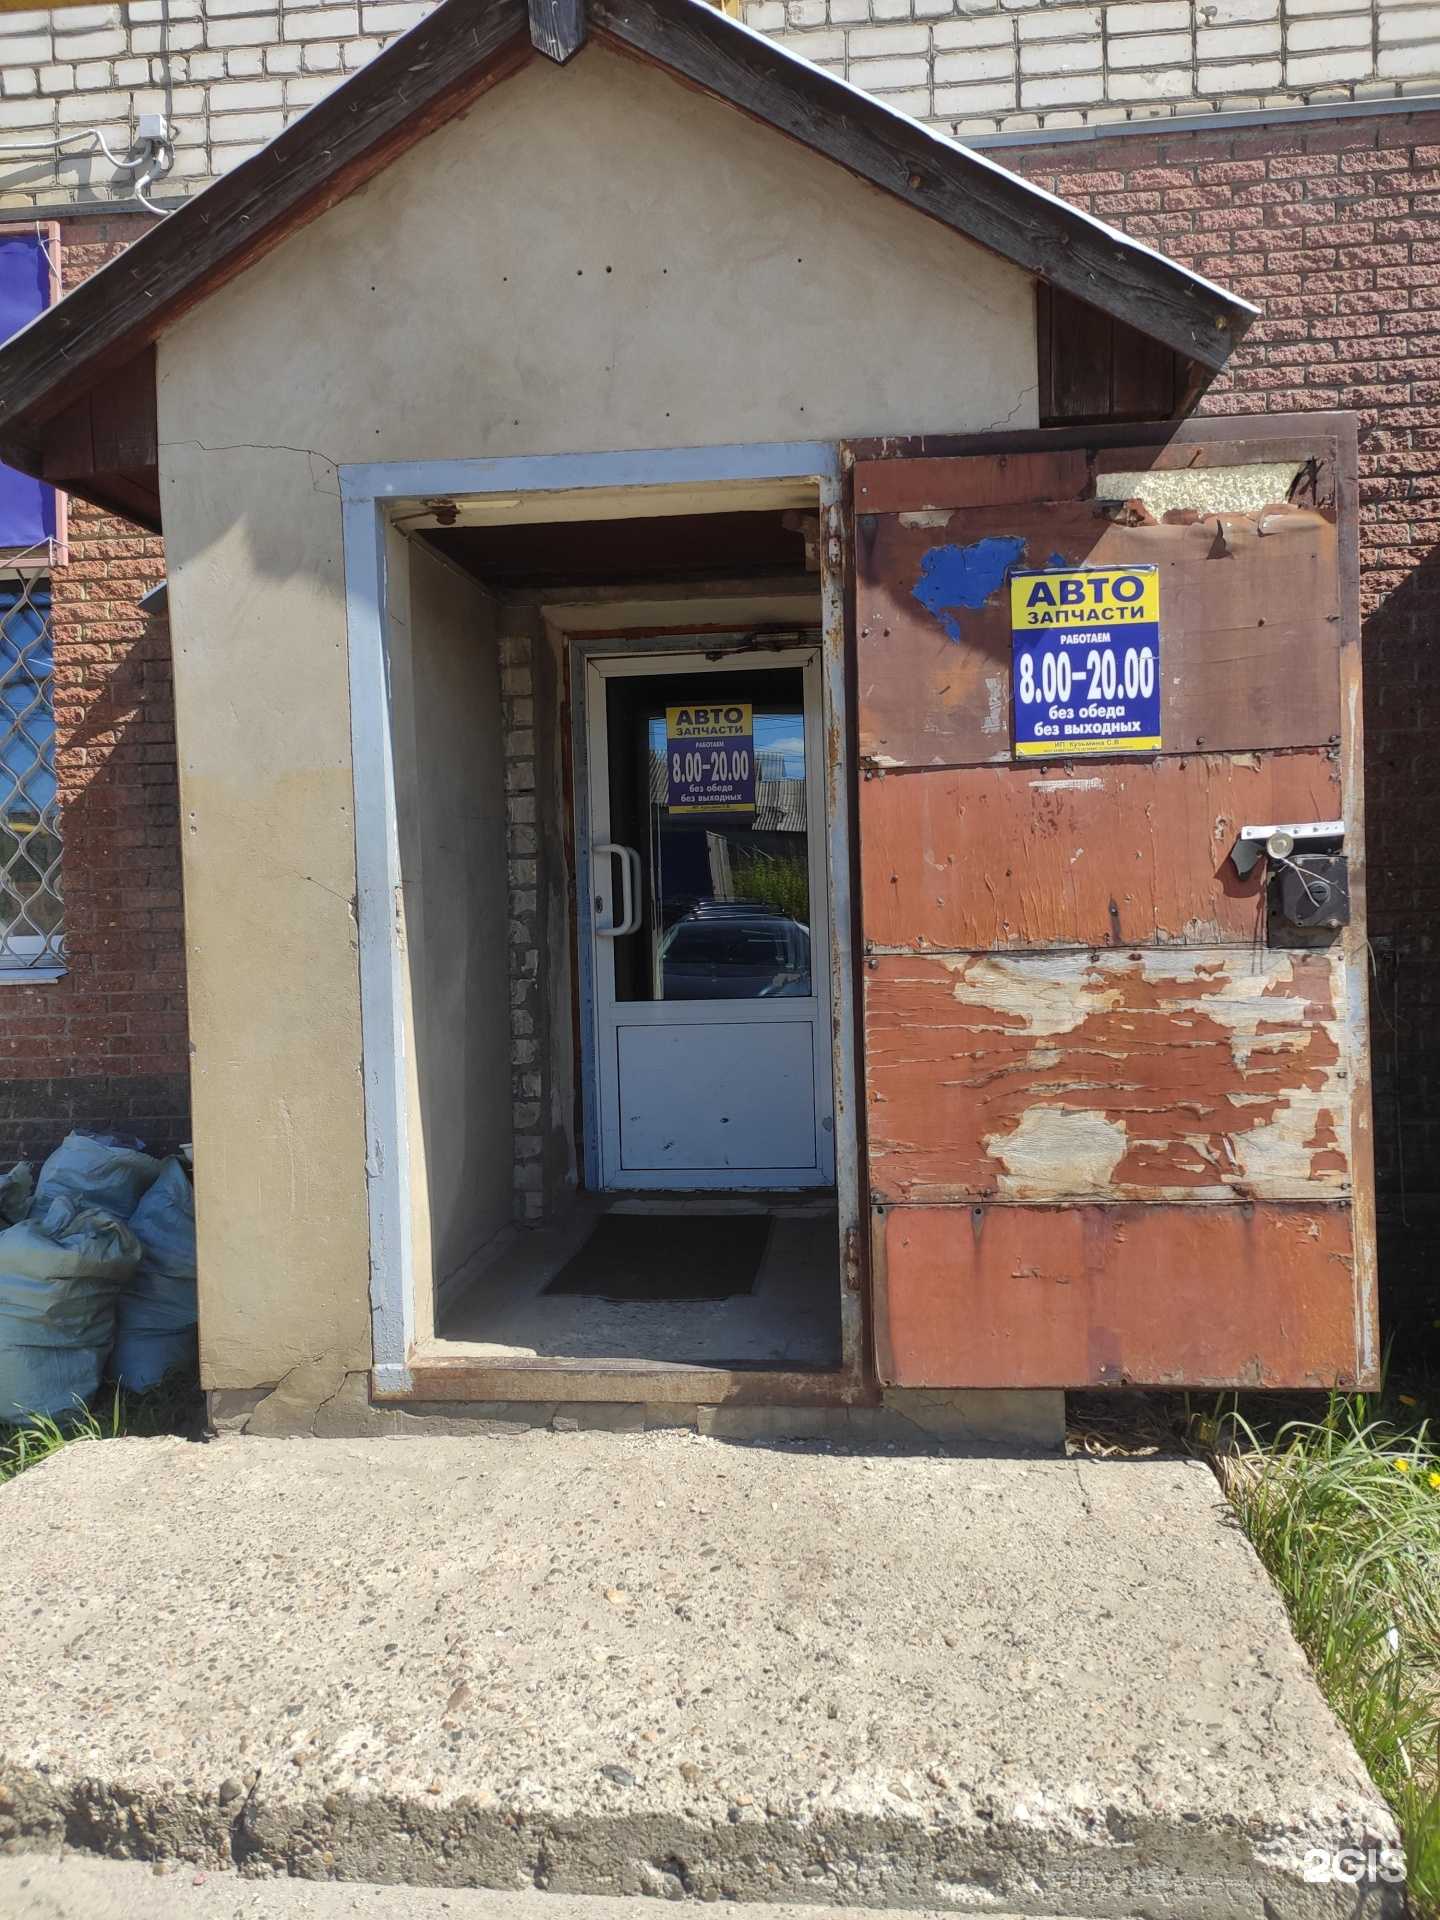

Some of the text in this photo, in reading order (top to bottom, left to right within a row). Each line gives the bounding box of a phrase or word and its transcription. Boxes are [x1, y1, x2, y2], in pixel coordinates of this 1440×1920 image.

[1026, 575, 1144, 608] АВТО
[1027, 606, 1144, 625] ЗАПЧАСТИ
[1060, 632, 1111, 645] РАБОТАЕМ
[676, 707, 744, 725] АВТО
[1048, 703, 1125, 720] без обеда
[676, 726, 744, 736] ЗАПЧАСТИ
[1034, 720, 1141, 737] без выходных
[695, 740, 725, 749] РАБОТАЕМ
[689, 783, 733, 793] без обеда
[680, 793, 742, 803] без выходных
